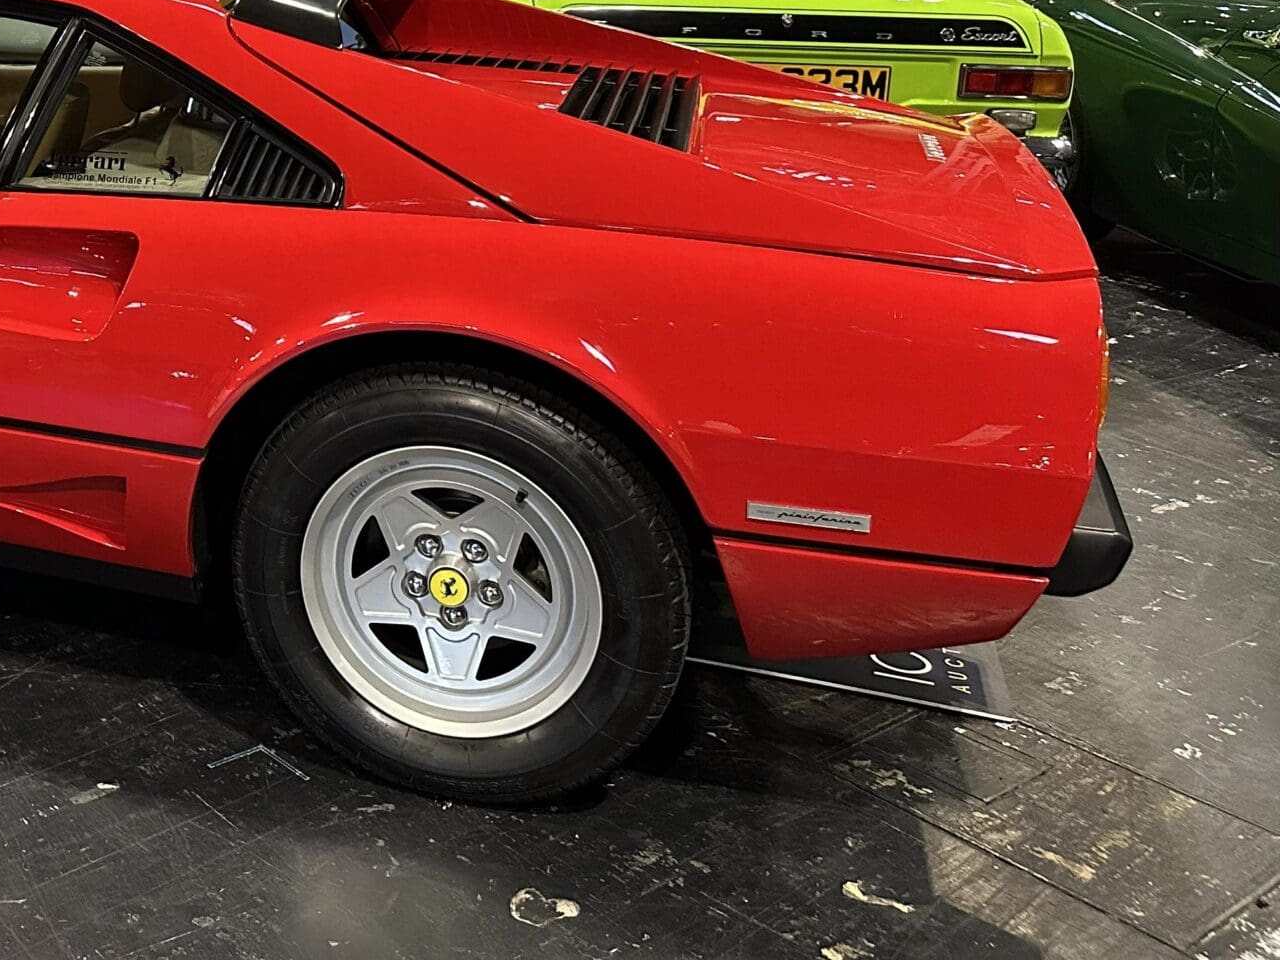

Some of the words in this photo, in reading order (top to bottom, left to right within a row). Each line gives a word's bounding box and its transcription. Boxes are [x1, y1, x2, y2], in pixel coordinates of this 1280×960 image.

[960, 26, 1018, 42] Escort
[98, 173, 142, 186] Mondiale
[145, 176, 158, 187] F1
[777, 511, 862, 526] pininfarina
